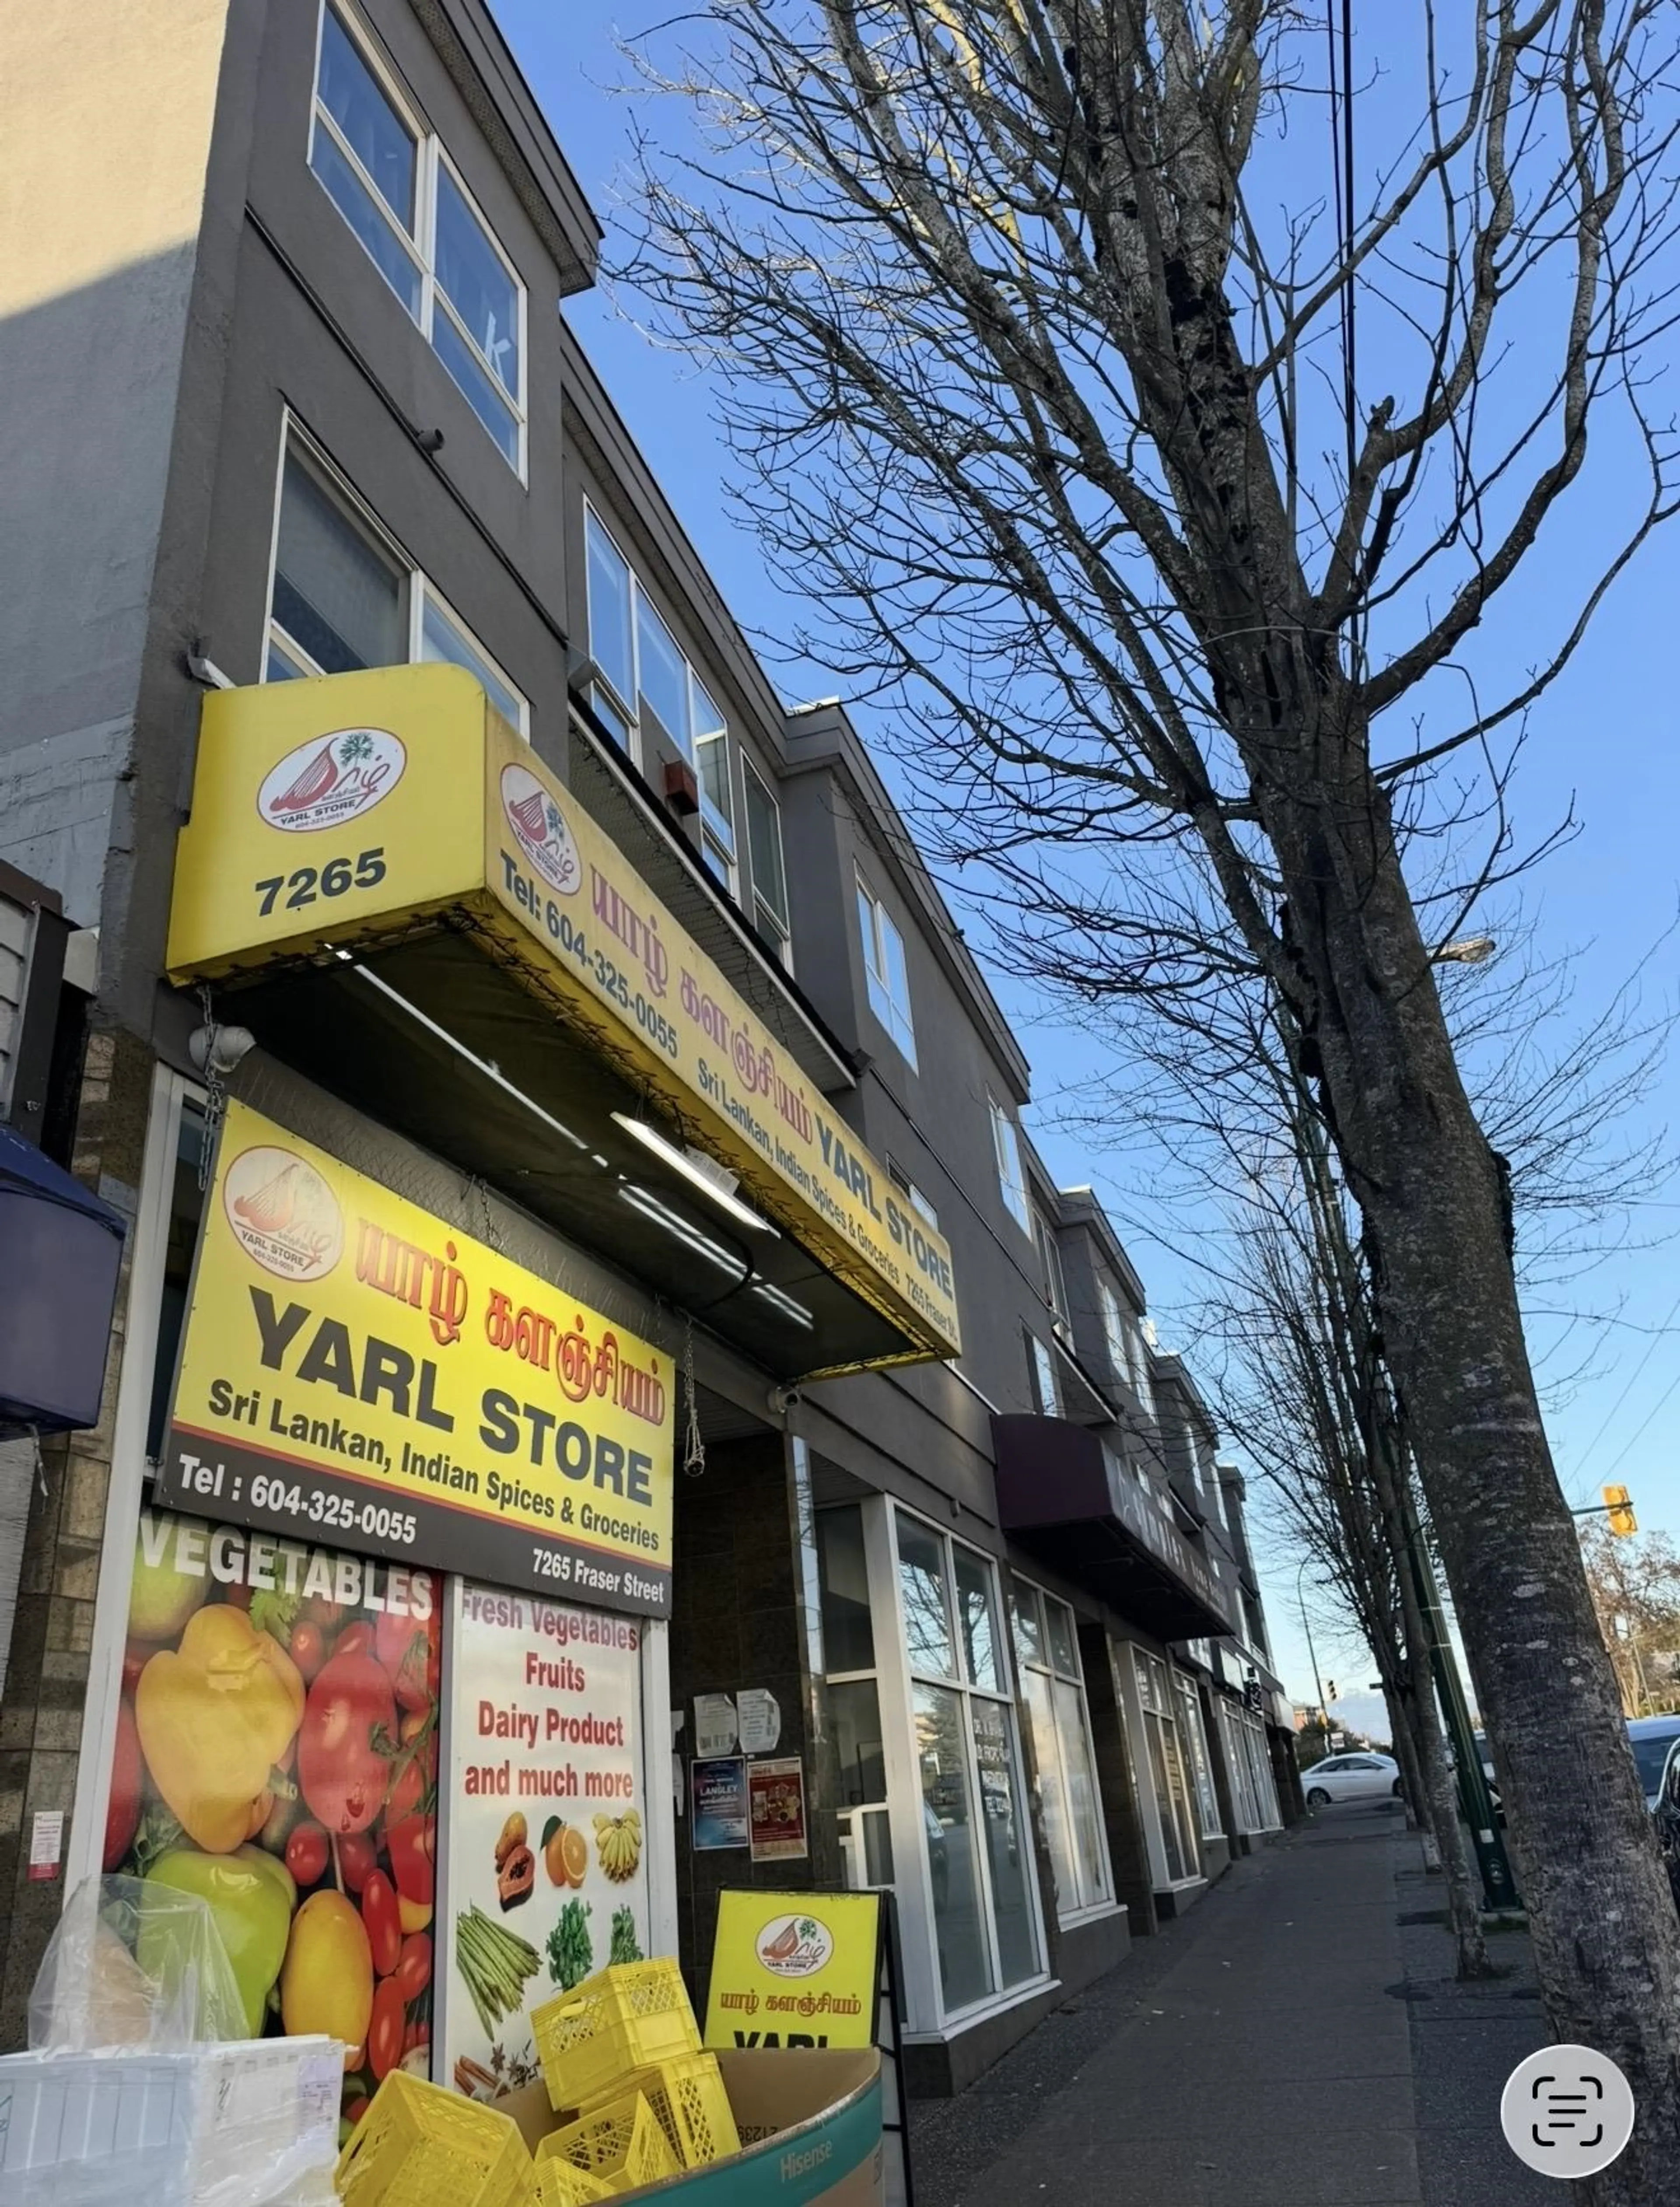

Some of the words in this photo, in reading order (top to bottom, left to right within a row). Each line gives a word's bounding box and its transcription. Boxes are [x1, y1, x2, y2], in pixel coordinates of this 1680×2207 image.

[280, 811, 311, 825] YARL
[315, 799, 355, 817] STORE
[255, 848, 386, 917] 7265
[500, 848, 540, 921] Tel:
[546, 900, 678, 1058] 604-325-0055
[590, 863, 668, 998] யாழ்
[680, 966, 812, 1145] களஞ்சியம்
[698, 1058, 718, 1101] Sri
[722, 1080, 774, 1161] Lankan,
[775, 1140, 810, 1191] Indian
[812, 1175, 847, 1230] Spices
[848, 1213, 856, 1239] &
[858, 1229, 900, 1284] Groceries
[815, 1112, 882, 1224] YARL
[885, 1197, 953, 1301] STORE
[242, 1230, 268, 1249] YARL
[271, 1244, 304, 1266] STORE
[356, 1218, 468, 1345] யாழ்
[485, 1287, 665, 1426] களஞ்சியம்
[248, 1285, 454, 1433] YARL
[480, 1388, 652, 1507] STORE
[209, 1379, 260, 1425] Sri
[270, 1399, 392, 1473] Lankan,
[401, 1443, 478, 1494] Indian
[486, 1471, 554, 1517] Spices
[561, 1497, 574, 1524] &
[581, 1503, 659, 1551] Groceries
[251, 1475, 416, 1544] 604-325-0055
[140, 1506, 433, 1620] VEGETABLES
[533, 1548, 570, 1580] 7265
[574, 1559, 621, 1591] Fraser
[624, 1573, 665, 1603] Street
[530, 1599, 638, 1650] Vegetables
[526, 1652, 585, 1692] Fruits
[479, 1701, 539, 1749] Dairy
[546, 1708, 623, 1747] Product
[465, 1759, 510, 1795] and
[518, 1763, 578, 1796] much
[584, 1768, 633, 1797] more
[720, 1988, 759, 2016] யாழ்
[765, 1990, 861, 2017] களஞ்சியம்
[780, 2140, 833, 2184] Hisense
